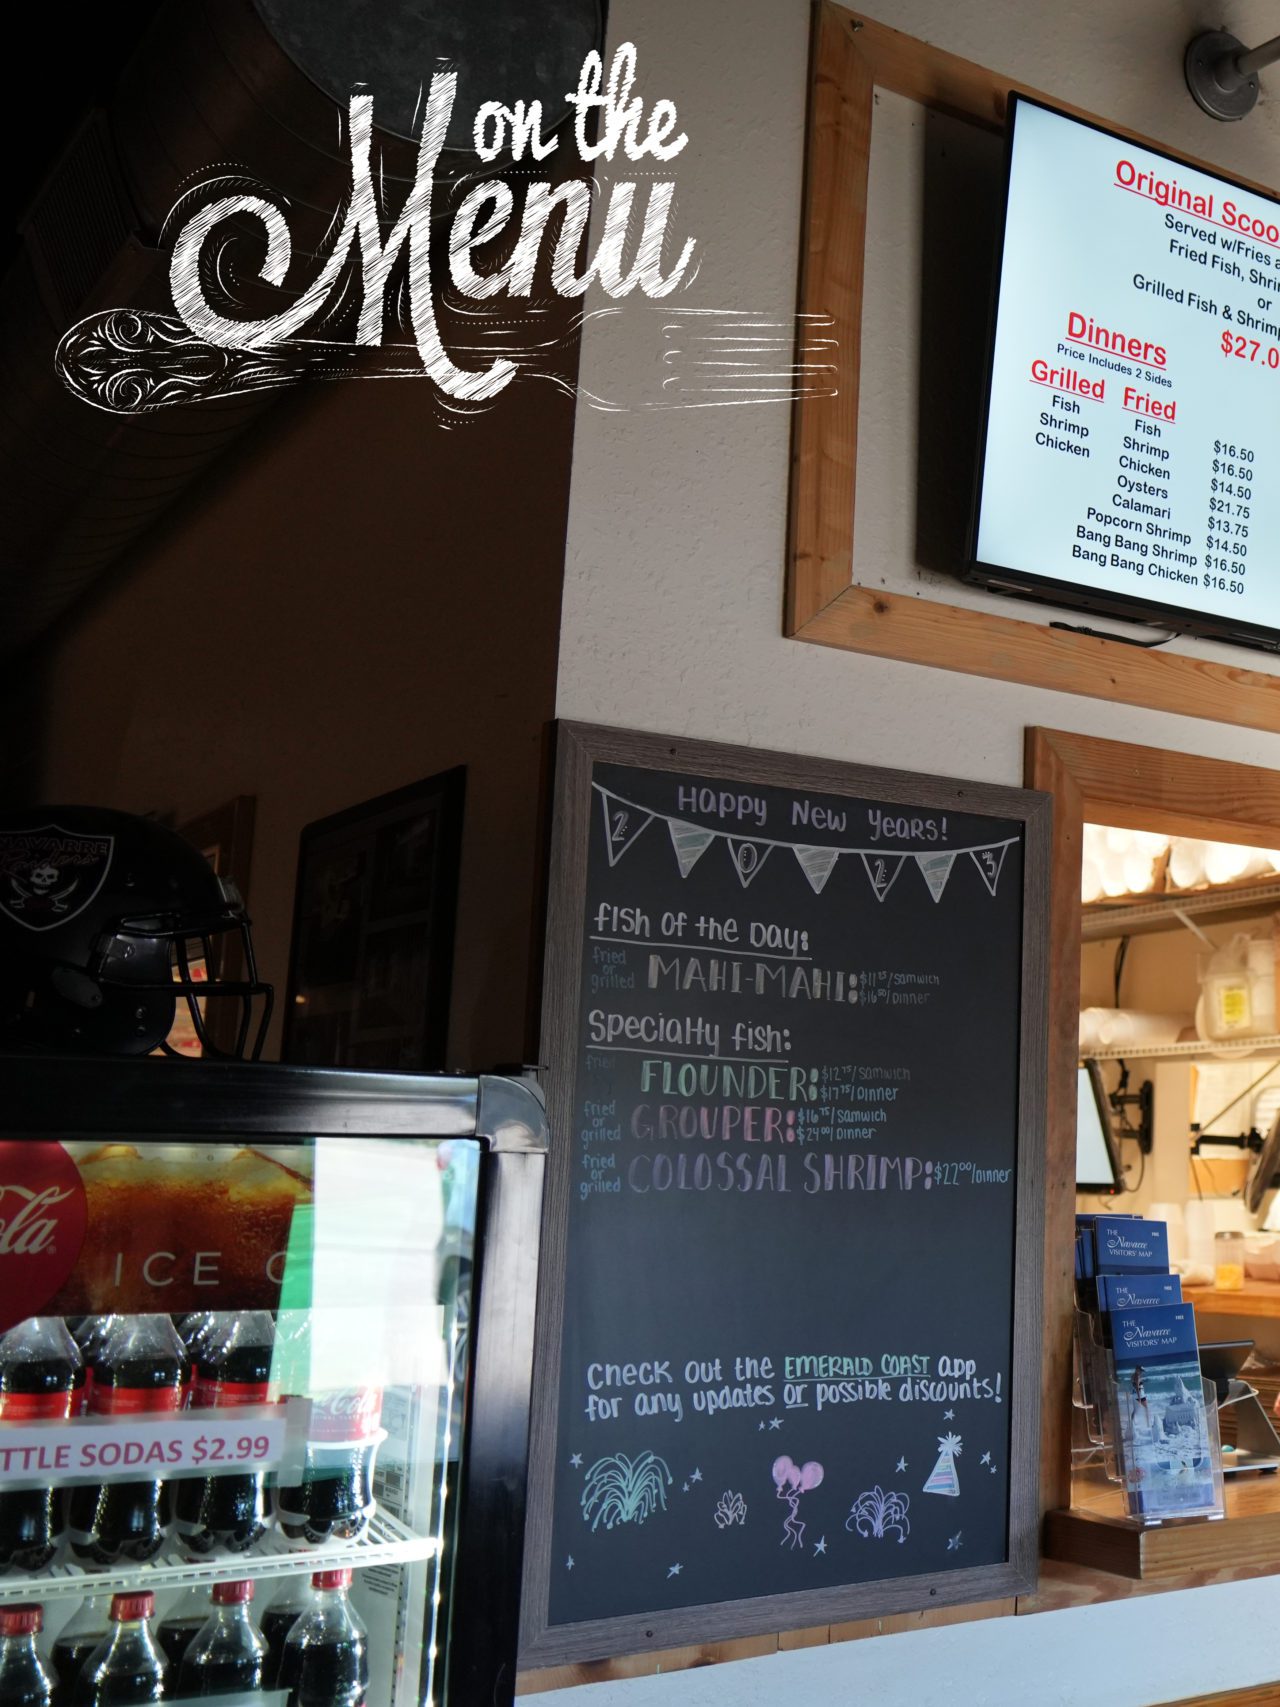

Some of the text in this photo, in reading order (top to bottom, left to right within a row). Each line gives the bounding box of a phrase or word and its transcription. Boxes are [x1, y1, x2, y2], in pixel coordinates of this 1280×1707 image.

[1116, 159, 1213, 218] Original
[1164, 213, 1217, 245] Served
[1220, 237, 1271, 266] w/Fries
[1169, 238, 1207, 265] Fried
[1211, 254, 1244, 282] Fish,
[1132, 273, 1184, 304] Grilled
[1187, 291, 1217, 315] Fish
[1221, 304, 1232, 321] &
[1257, 297, 1272, 311] or
[1067, 311, 1166, 365] Dinners
[1056, 342, 1172, 388] Price Includes 2 Sides
[1031, 359, 1176, 421] Grilled Fried
[1112, 493, 1248, 538] Calamari $13.75
[1117, 474, 1250, 519] Oysters $21.75
[1086, 506, 1247, 557] Popcorn Shrimp $14.50
[1072, 544, 1244, 595] Bang Bang Chicken $16.50
[678, 785, 948, 841] Happy New Years!
[661, 912, 687, 937] of
[694, 914, 739, 943] the
[750, 921, 809, 957] Day:
[588, 1010, 720, 1057] Specialty
[640, 1060, 819, 1101] FLOUNDER:
[583, 1100, 616, 1117] fried
[631, 1104, 795, 1143] GROUPER:
[582, 1124, 622, 1145] grilled
[582, 1153, 616, 1169] fried
[628, 1153, 933, 1194] COLOSSAL SHRIMP:
[580, 1178, 622, 1202] grilled
[114, 1252, 222, 1287] ICE
[1161, 1336, 1178, 1344] MAP
[587, 1354, 976, 1390] Check out the EMERALD COAST app
[584, 1372, 1003, 1423] for any updates or possible discounts!
[80, 1440, 183, 1468] SODAS
[191, 1435, 270, 1465] $2.99
